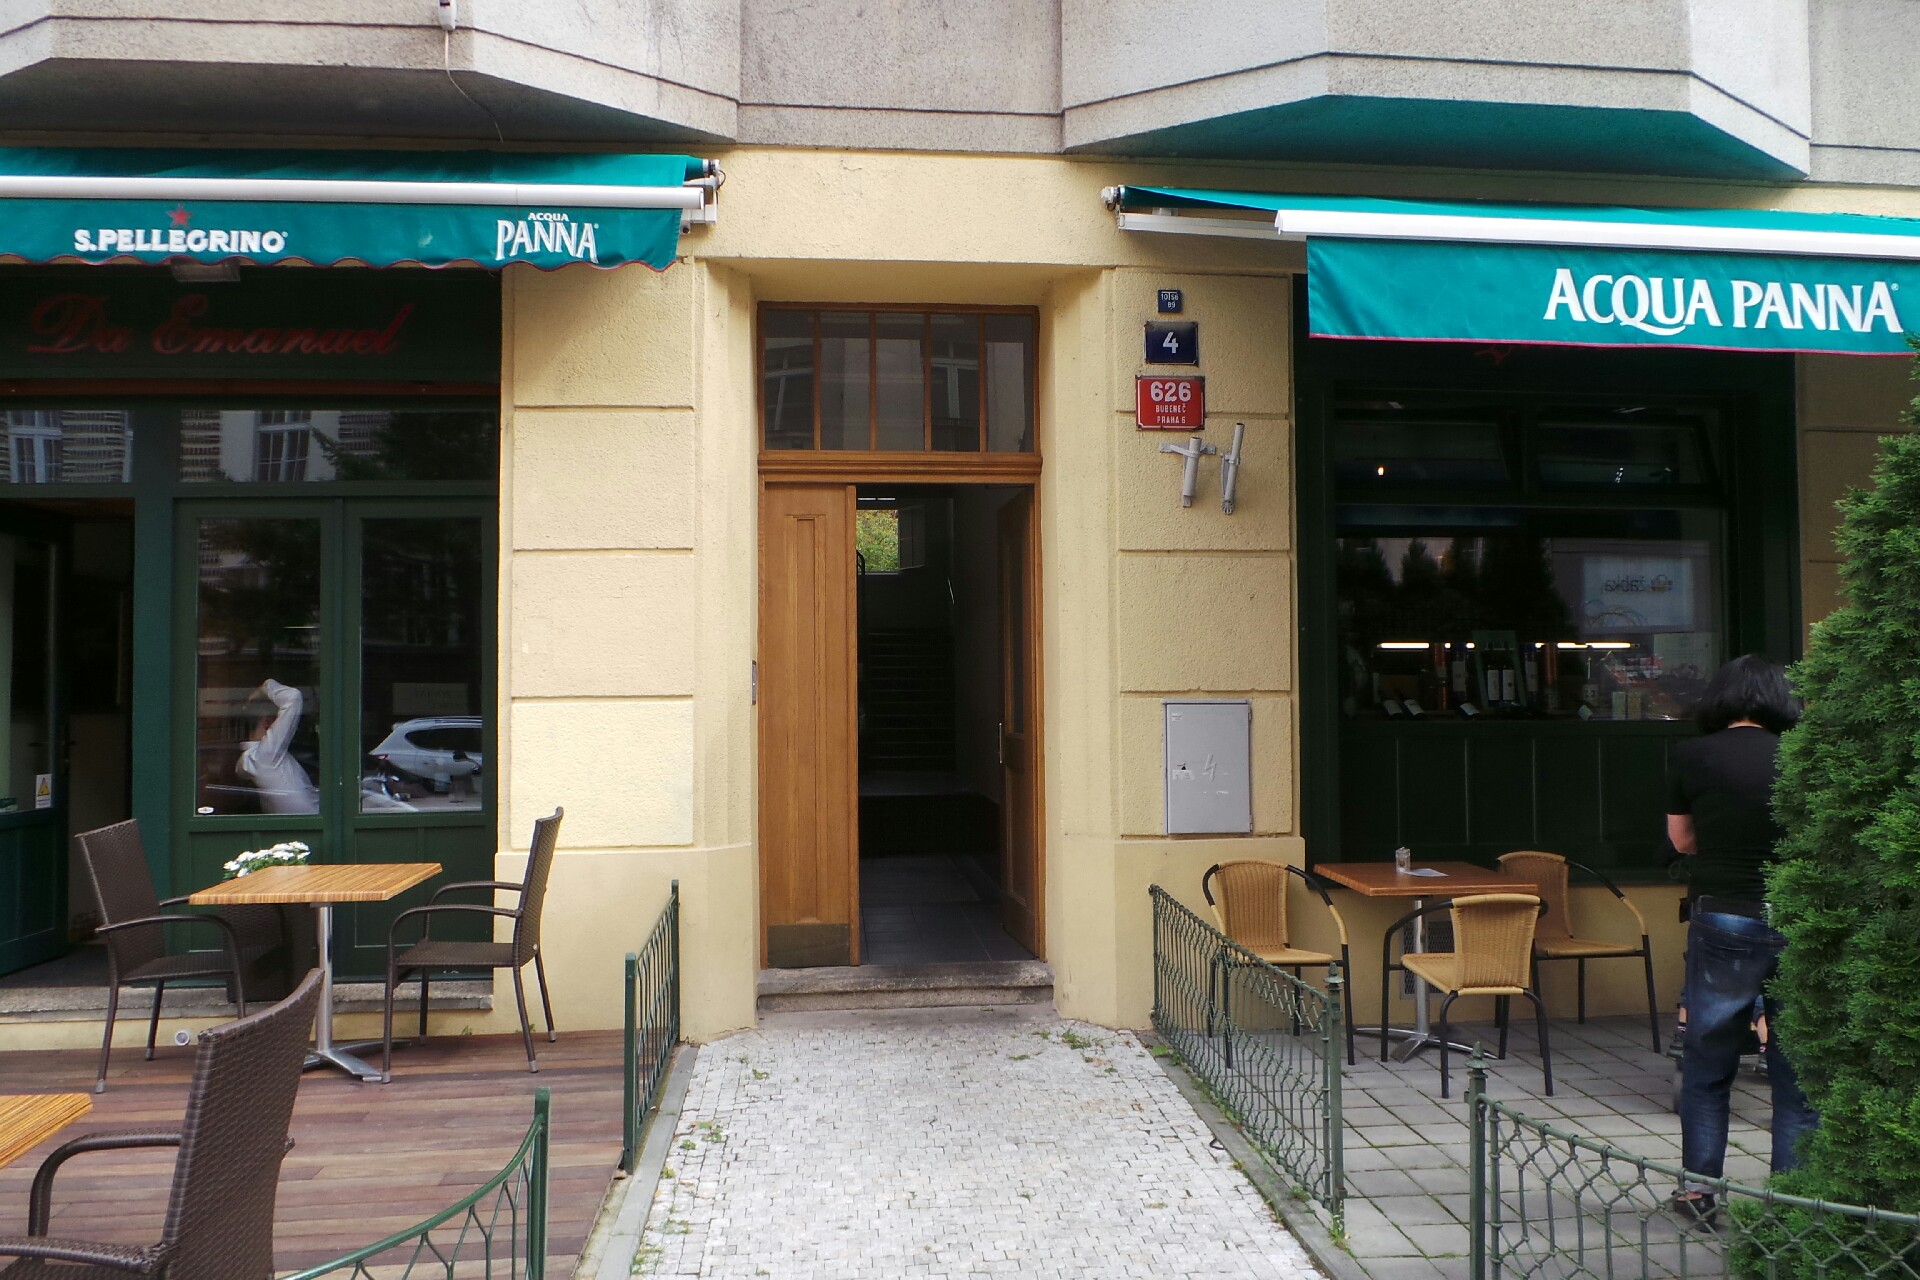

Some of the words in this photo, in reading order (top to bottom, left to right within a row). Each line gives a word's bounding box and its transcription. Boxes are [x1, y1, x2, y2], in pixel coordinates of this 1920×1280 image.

[528, 212, 570, 222] ACQUA
[74, 229, 286, 254] S.PELLEGRINO
[496, 219, 599, 264] PANNA
[1543, 268, 1724, 336] ACQUA
[1731, 279, 1904, 333] PANNA
[25, 293, 133, 353] Da
[151, 293, 414, 355] Emanuel
[1162, 331, 1179, 354] 4
[1150, 381, 1192, 402] 626
[1156, 416, 1180, 424] PRAHA
[1181, 416, 1186, 424] 6
